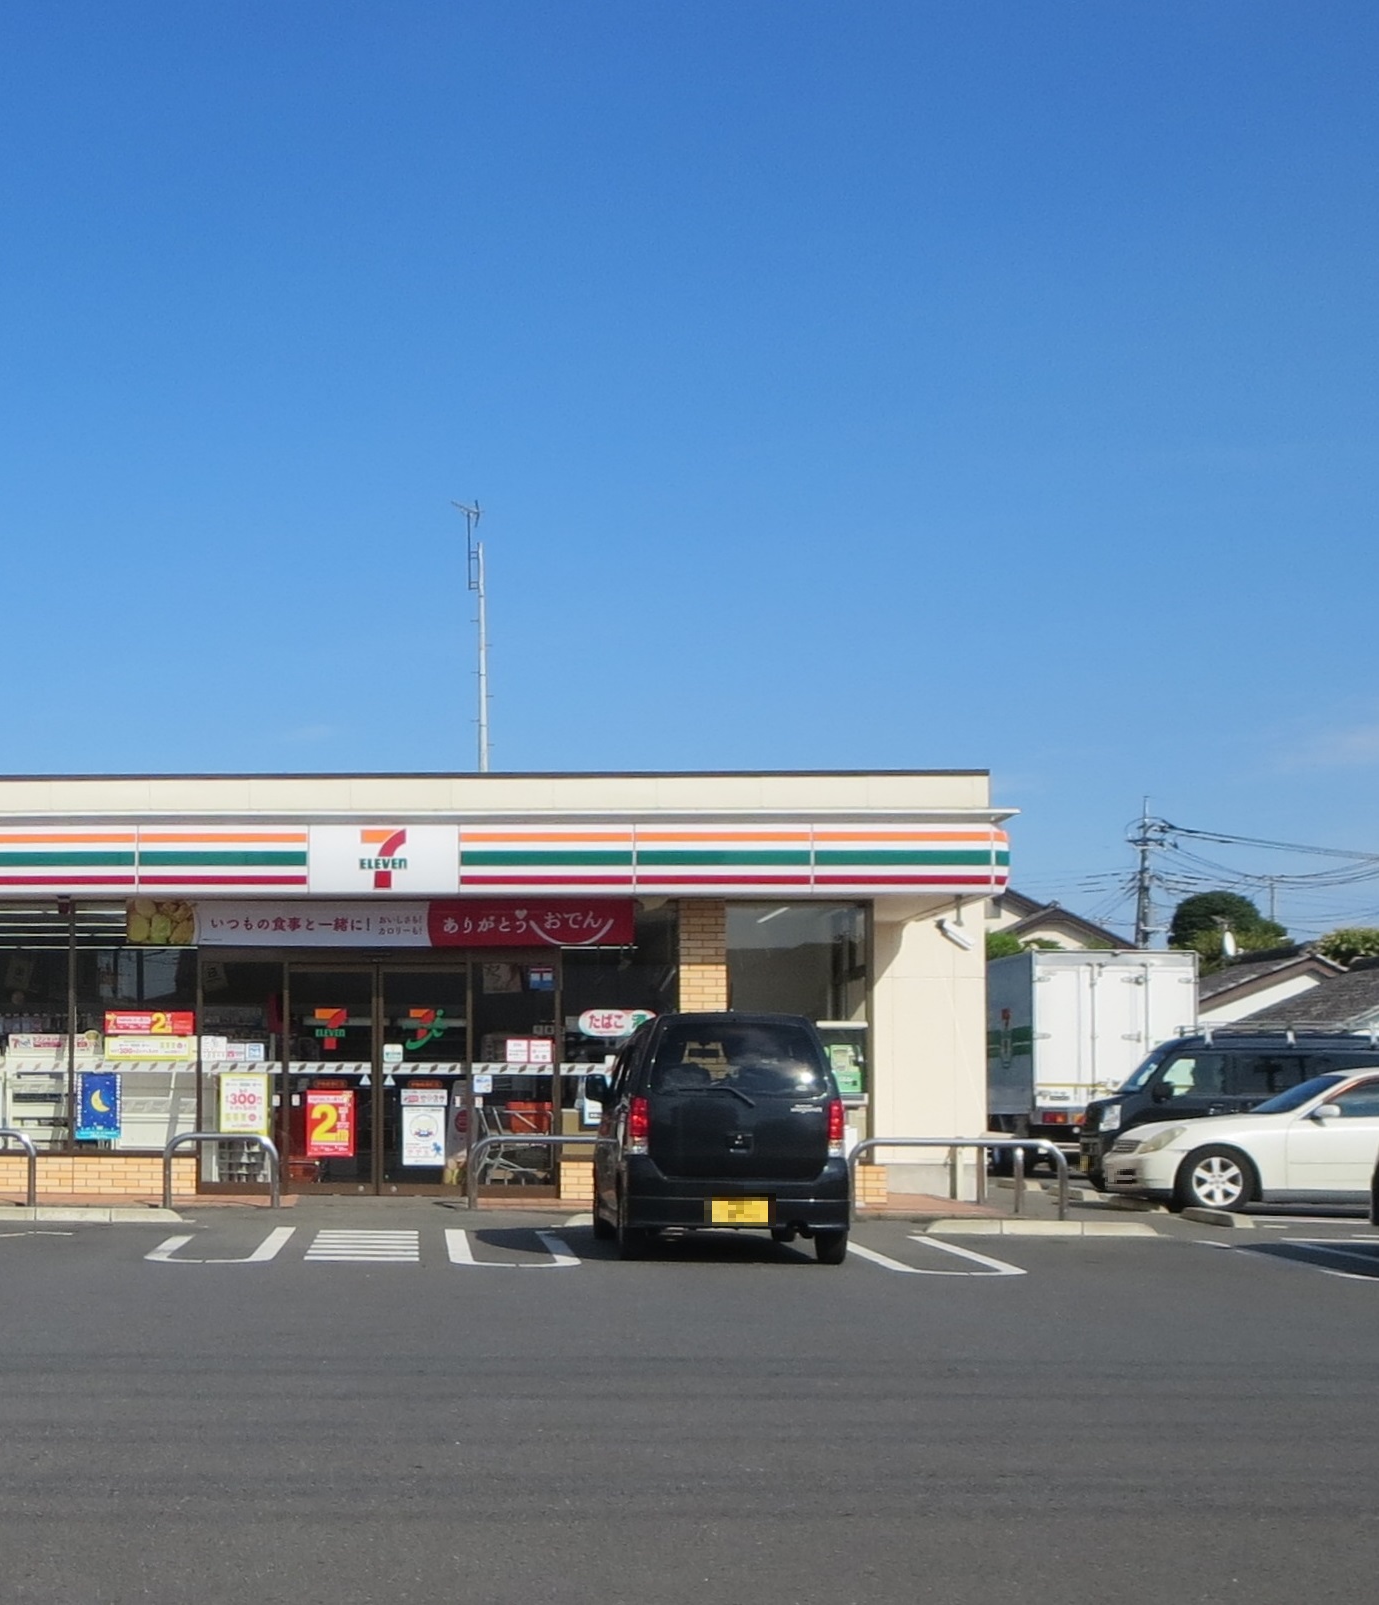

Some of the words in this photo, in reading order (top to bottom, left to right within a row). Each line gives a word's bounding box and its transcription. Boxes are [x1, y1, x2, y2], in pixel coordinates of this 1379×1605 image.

[360, 828, 406, 889] 7
[544, 911, 601, 929] おでん
[589, 1014, 625, 1029] たばこ
